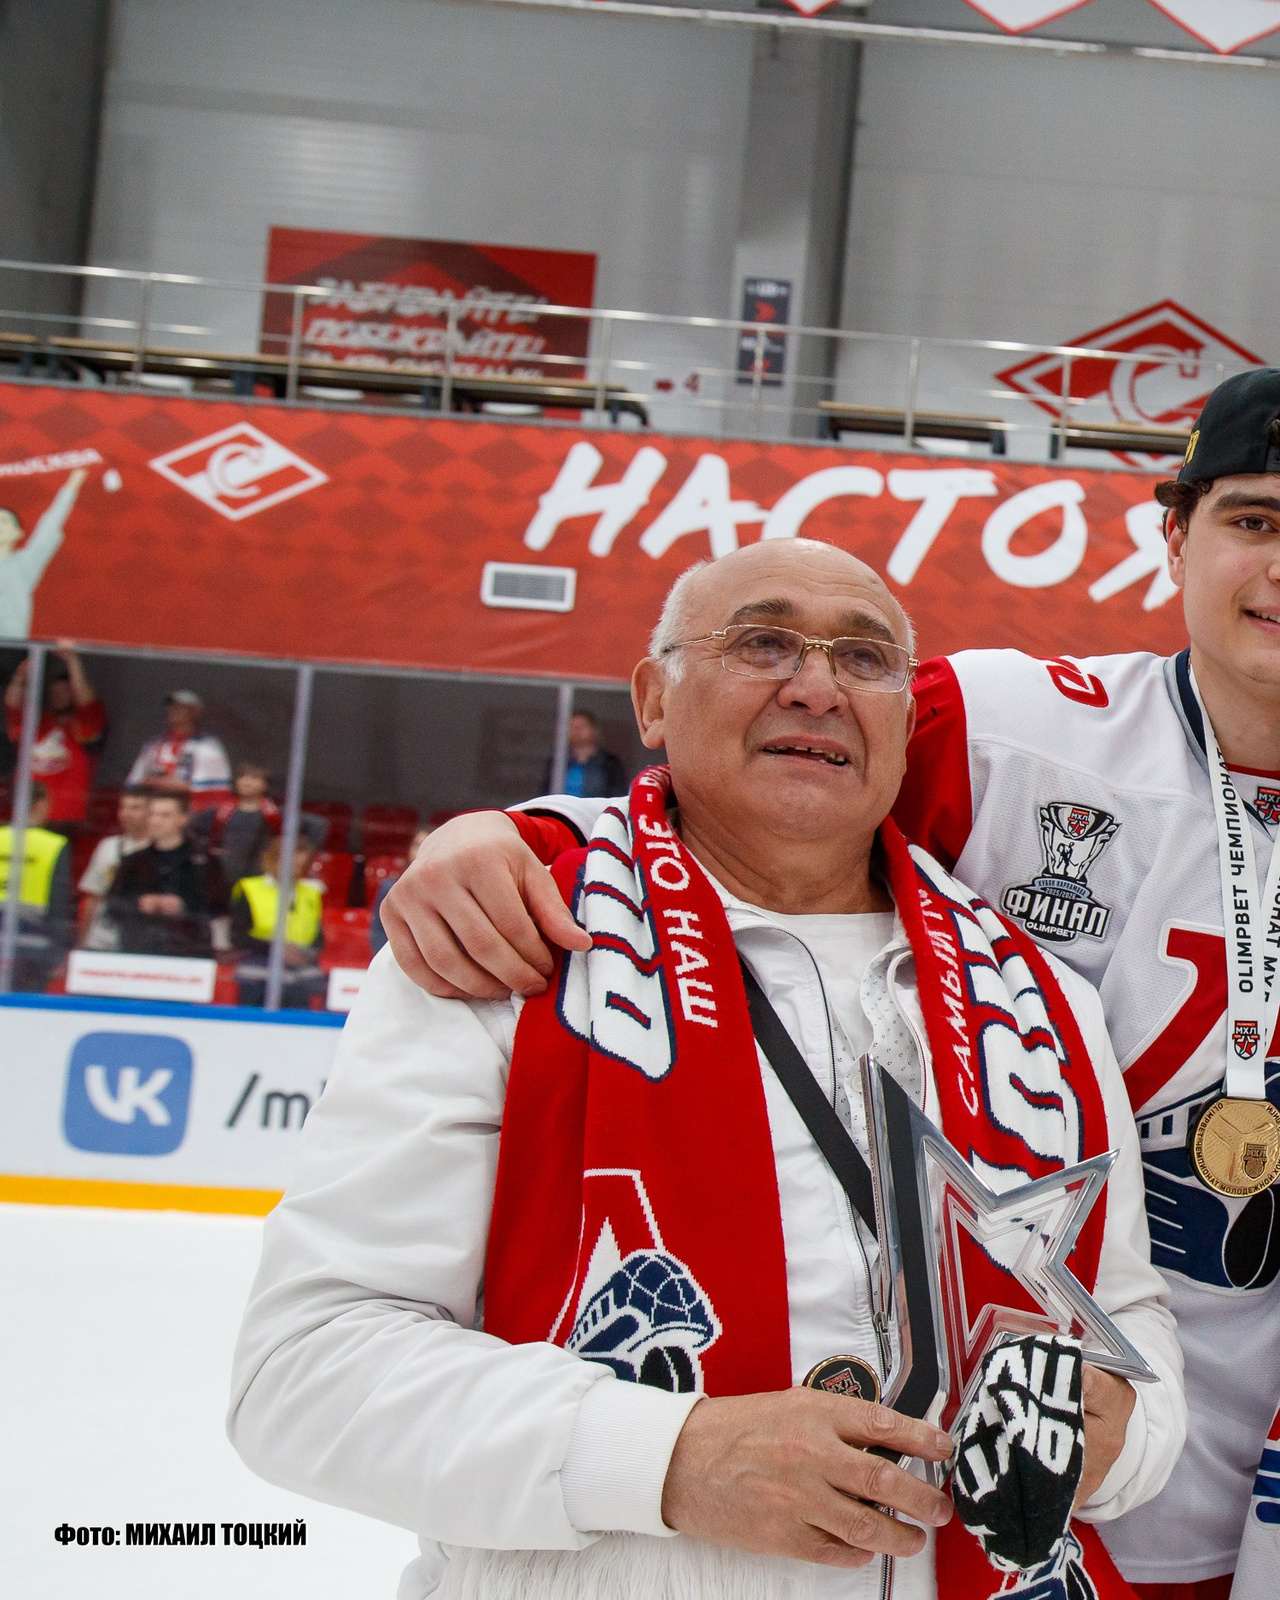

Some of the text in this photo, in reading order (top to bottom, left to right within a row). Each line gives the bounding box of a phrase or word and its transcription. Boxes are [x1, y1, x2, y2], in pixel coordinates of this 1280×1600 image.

[637, 813, 690, 891] ЭТО
[1005, 889, 1108, 936] ФИНАЛ
[1026, 921, 1077, 938] OLIMPBET
[1231, 885, 1254, 993] OLIMPBET
[662, 908, 719, 1028] НАШ
[225, 1071, 328, 1132] /m
[1195, 1142, 1220, 1187] ЧЕМПИОНАТ
[1220, 1174, 1275, 1196] МОЛОДЕЖНОЙ
